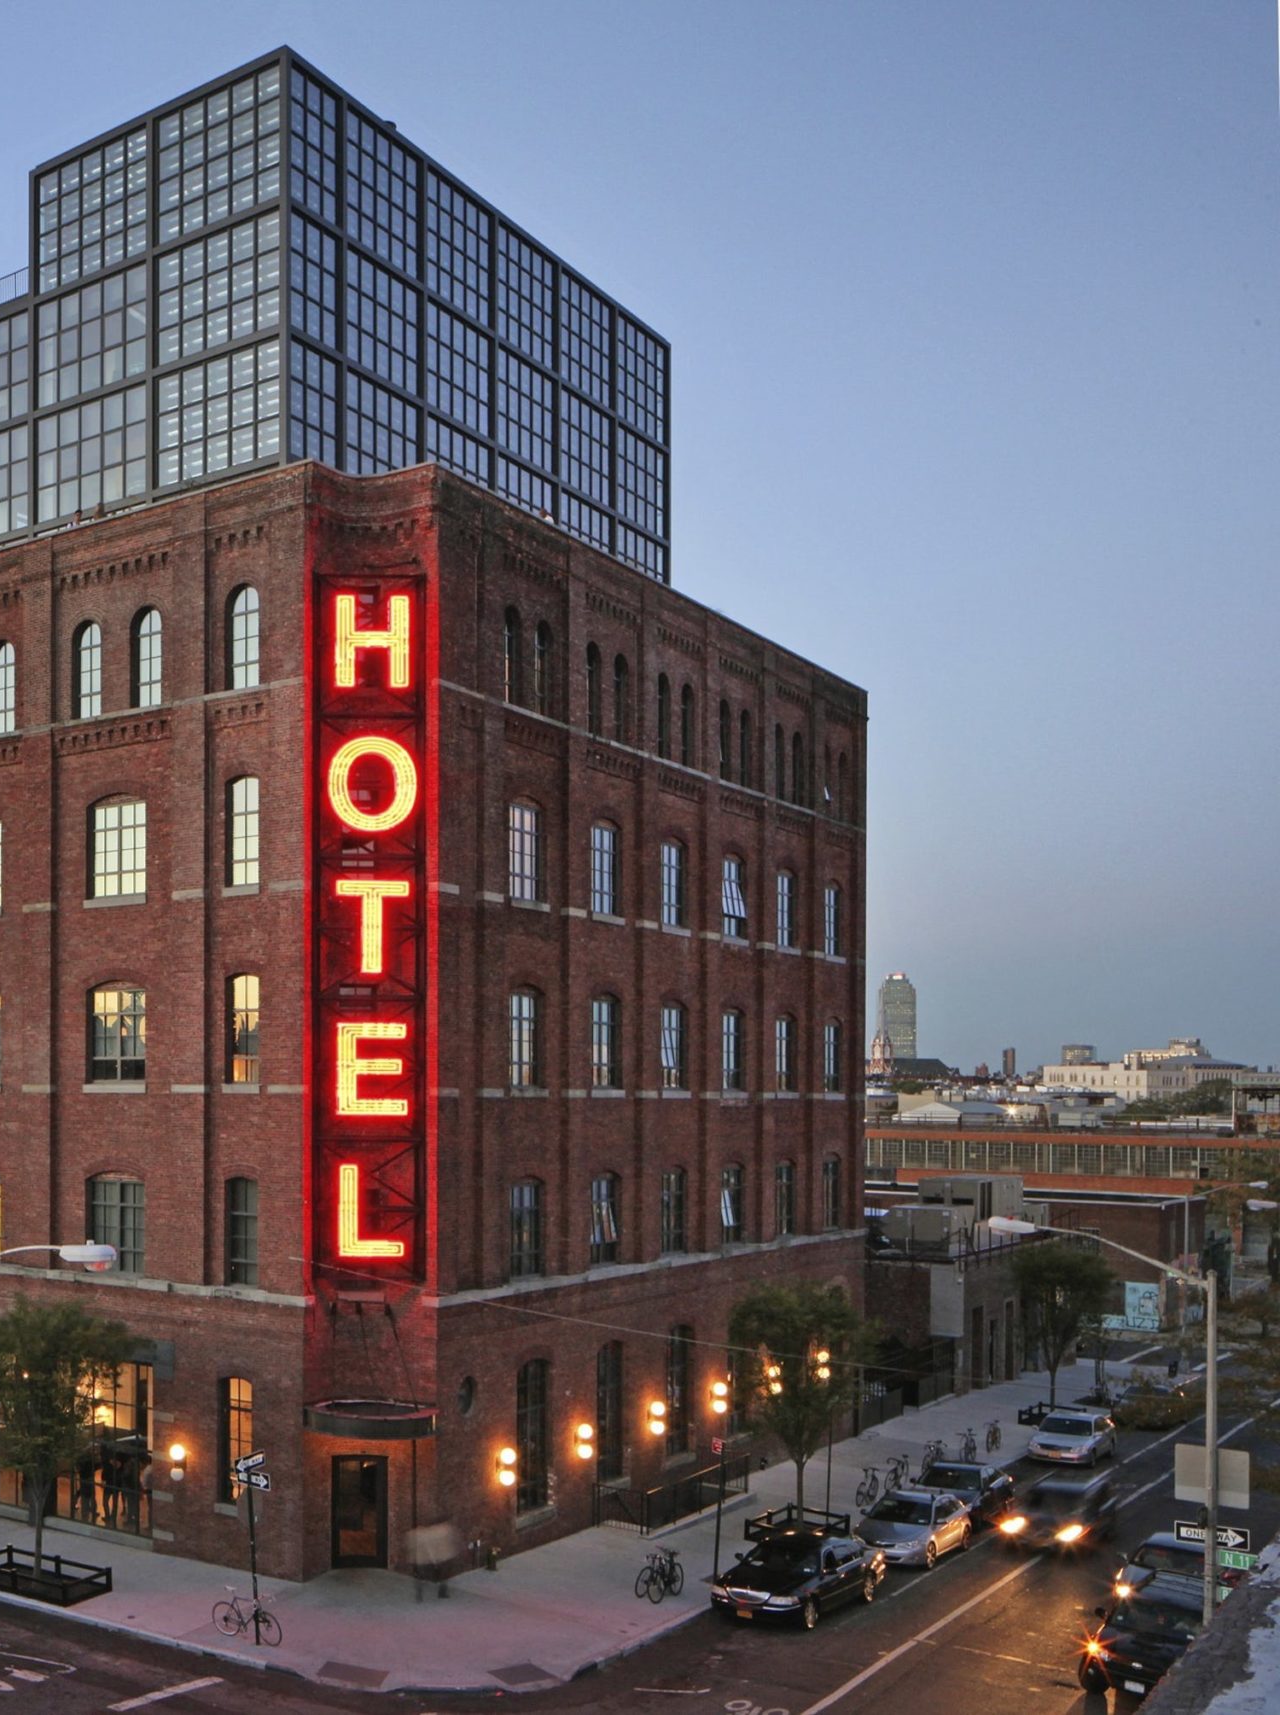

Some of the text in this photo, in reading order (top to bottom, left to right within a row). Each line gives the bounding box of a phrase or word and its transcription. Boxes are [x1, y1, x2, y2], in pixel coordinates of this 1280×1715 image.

[327, 594, 418, 1259] HOTEL
[1185, 1529, 1206, 1537] ONE
[1225, 1552, 1250, 1569] N 11
